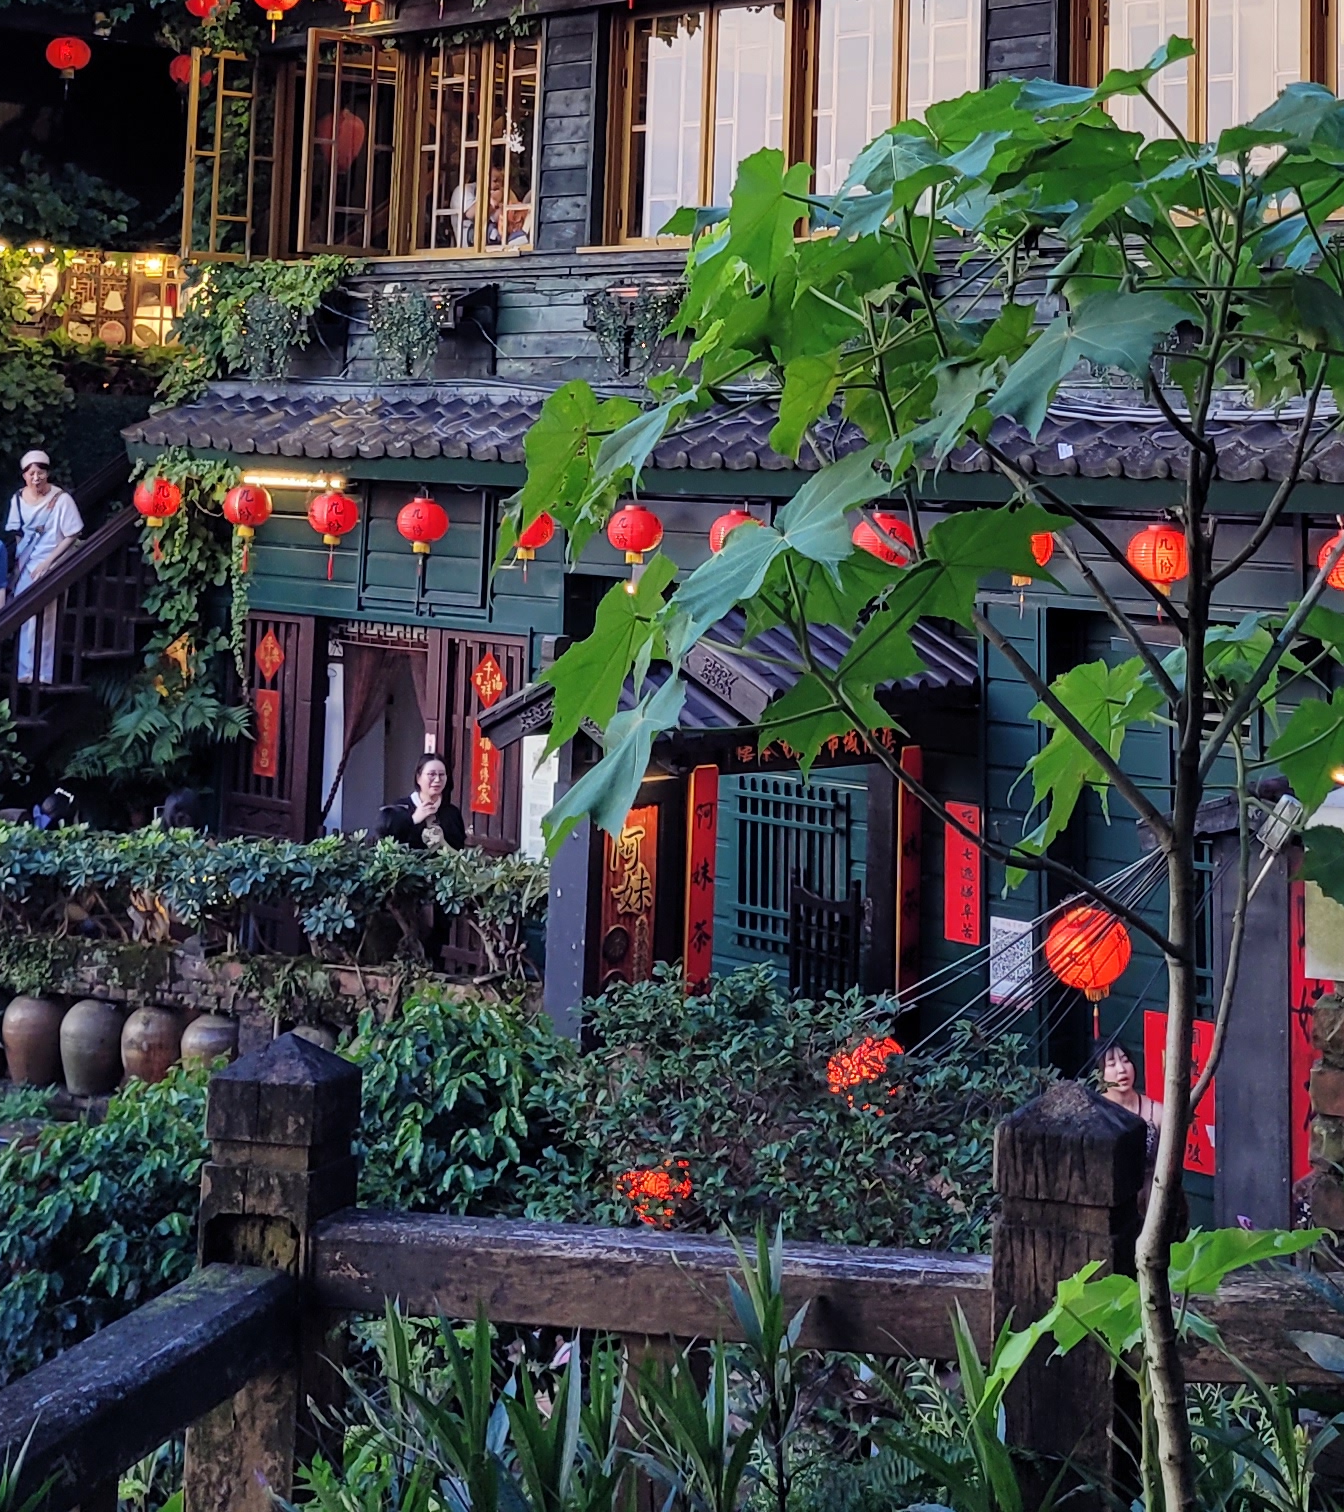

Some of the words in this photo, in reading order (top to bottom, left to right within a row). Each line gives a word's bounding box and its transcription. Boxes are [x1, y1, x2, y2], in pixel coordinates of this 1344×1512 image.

[238, 489, 254, 518] 九份
[328, 502, 344, 532] 九份
[1158, 537, 1175, 576] 九份
[691, 801, 716, 988] 阿妹茶
